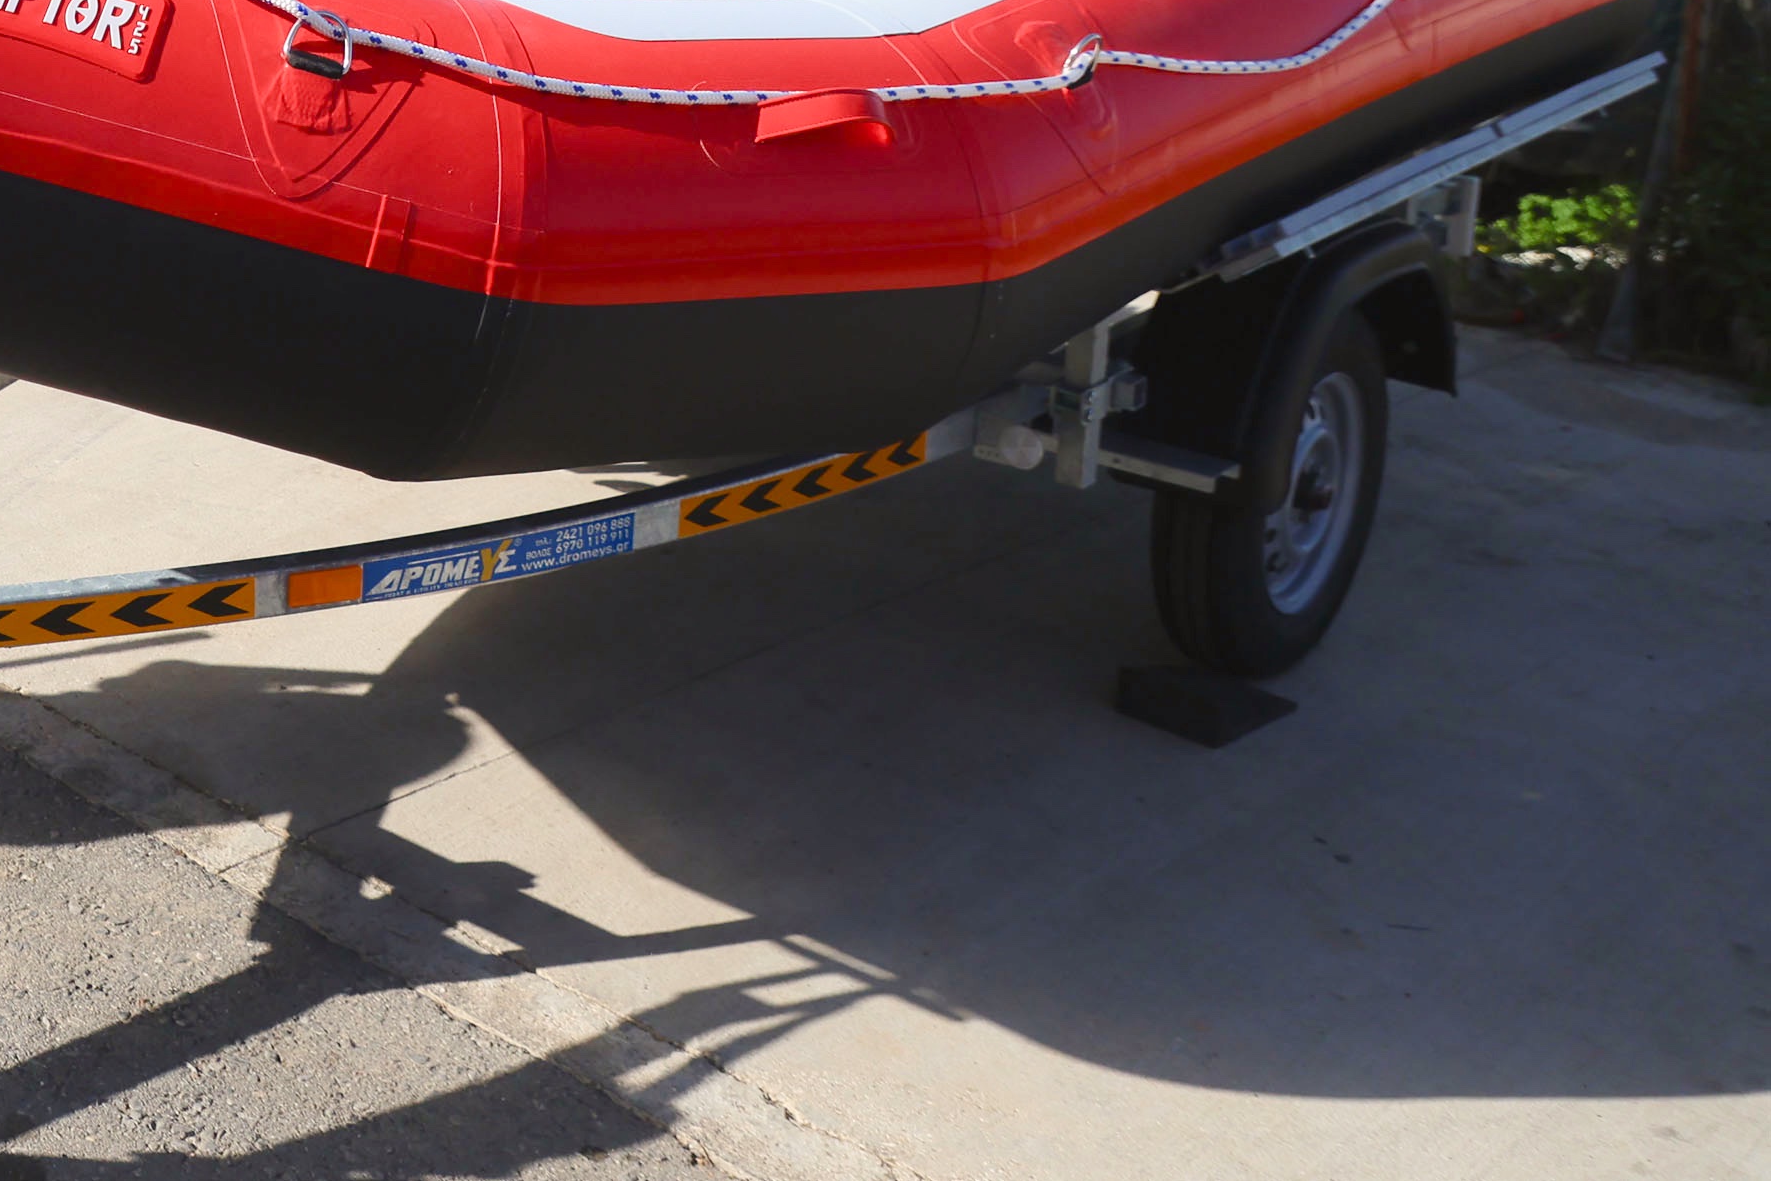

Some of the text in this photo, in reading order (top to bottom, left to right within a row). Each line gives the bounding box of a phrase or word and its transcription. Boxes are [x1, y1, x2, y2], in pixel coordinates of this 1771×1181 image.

[556, 527, 583, 542] 2421
[587, 522, 607, 536] 096
[556, 539, 583, 554] 6970
[588, 534, 607, 546] 119
[610, 529, 629, 540] 911
[521, 541, 629, 571] www.dromeys.gr
